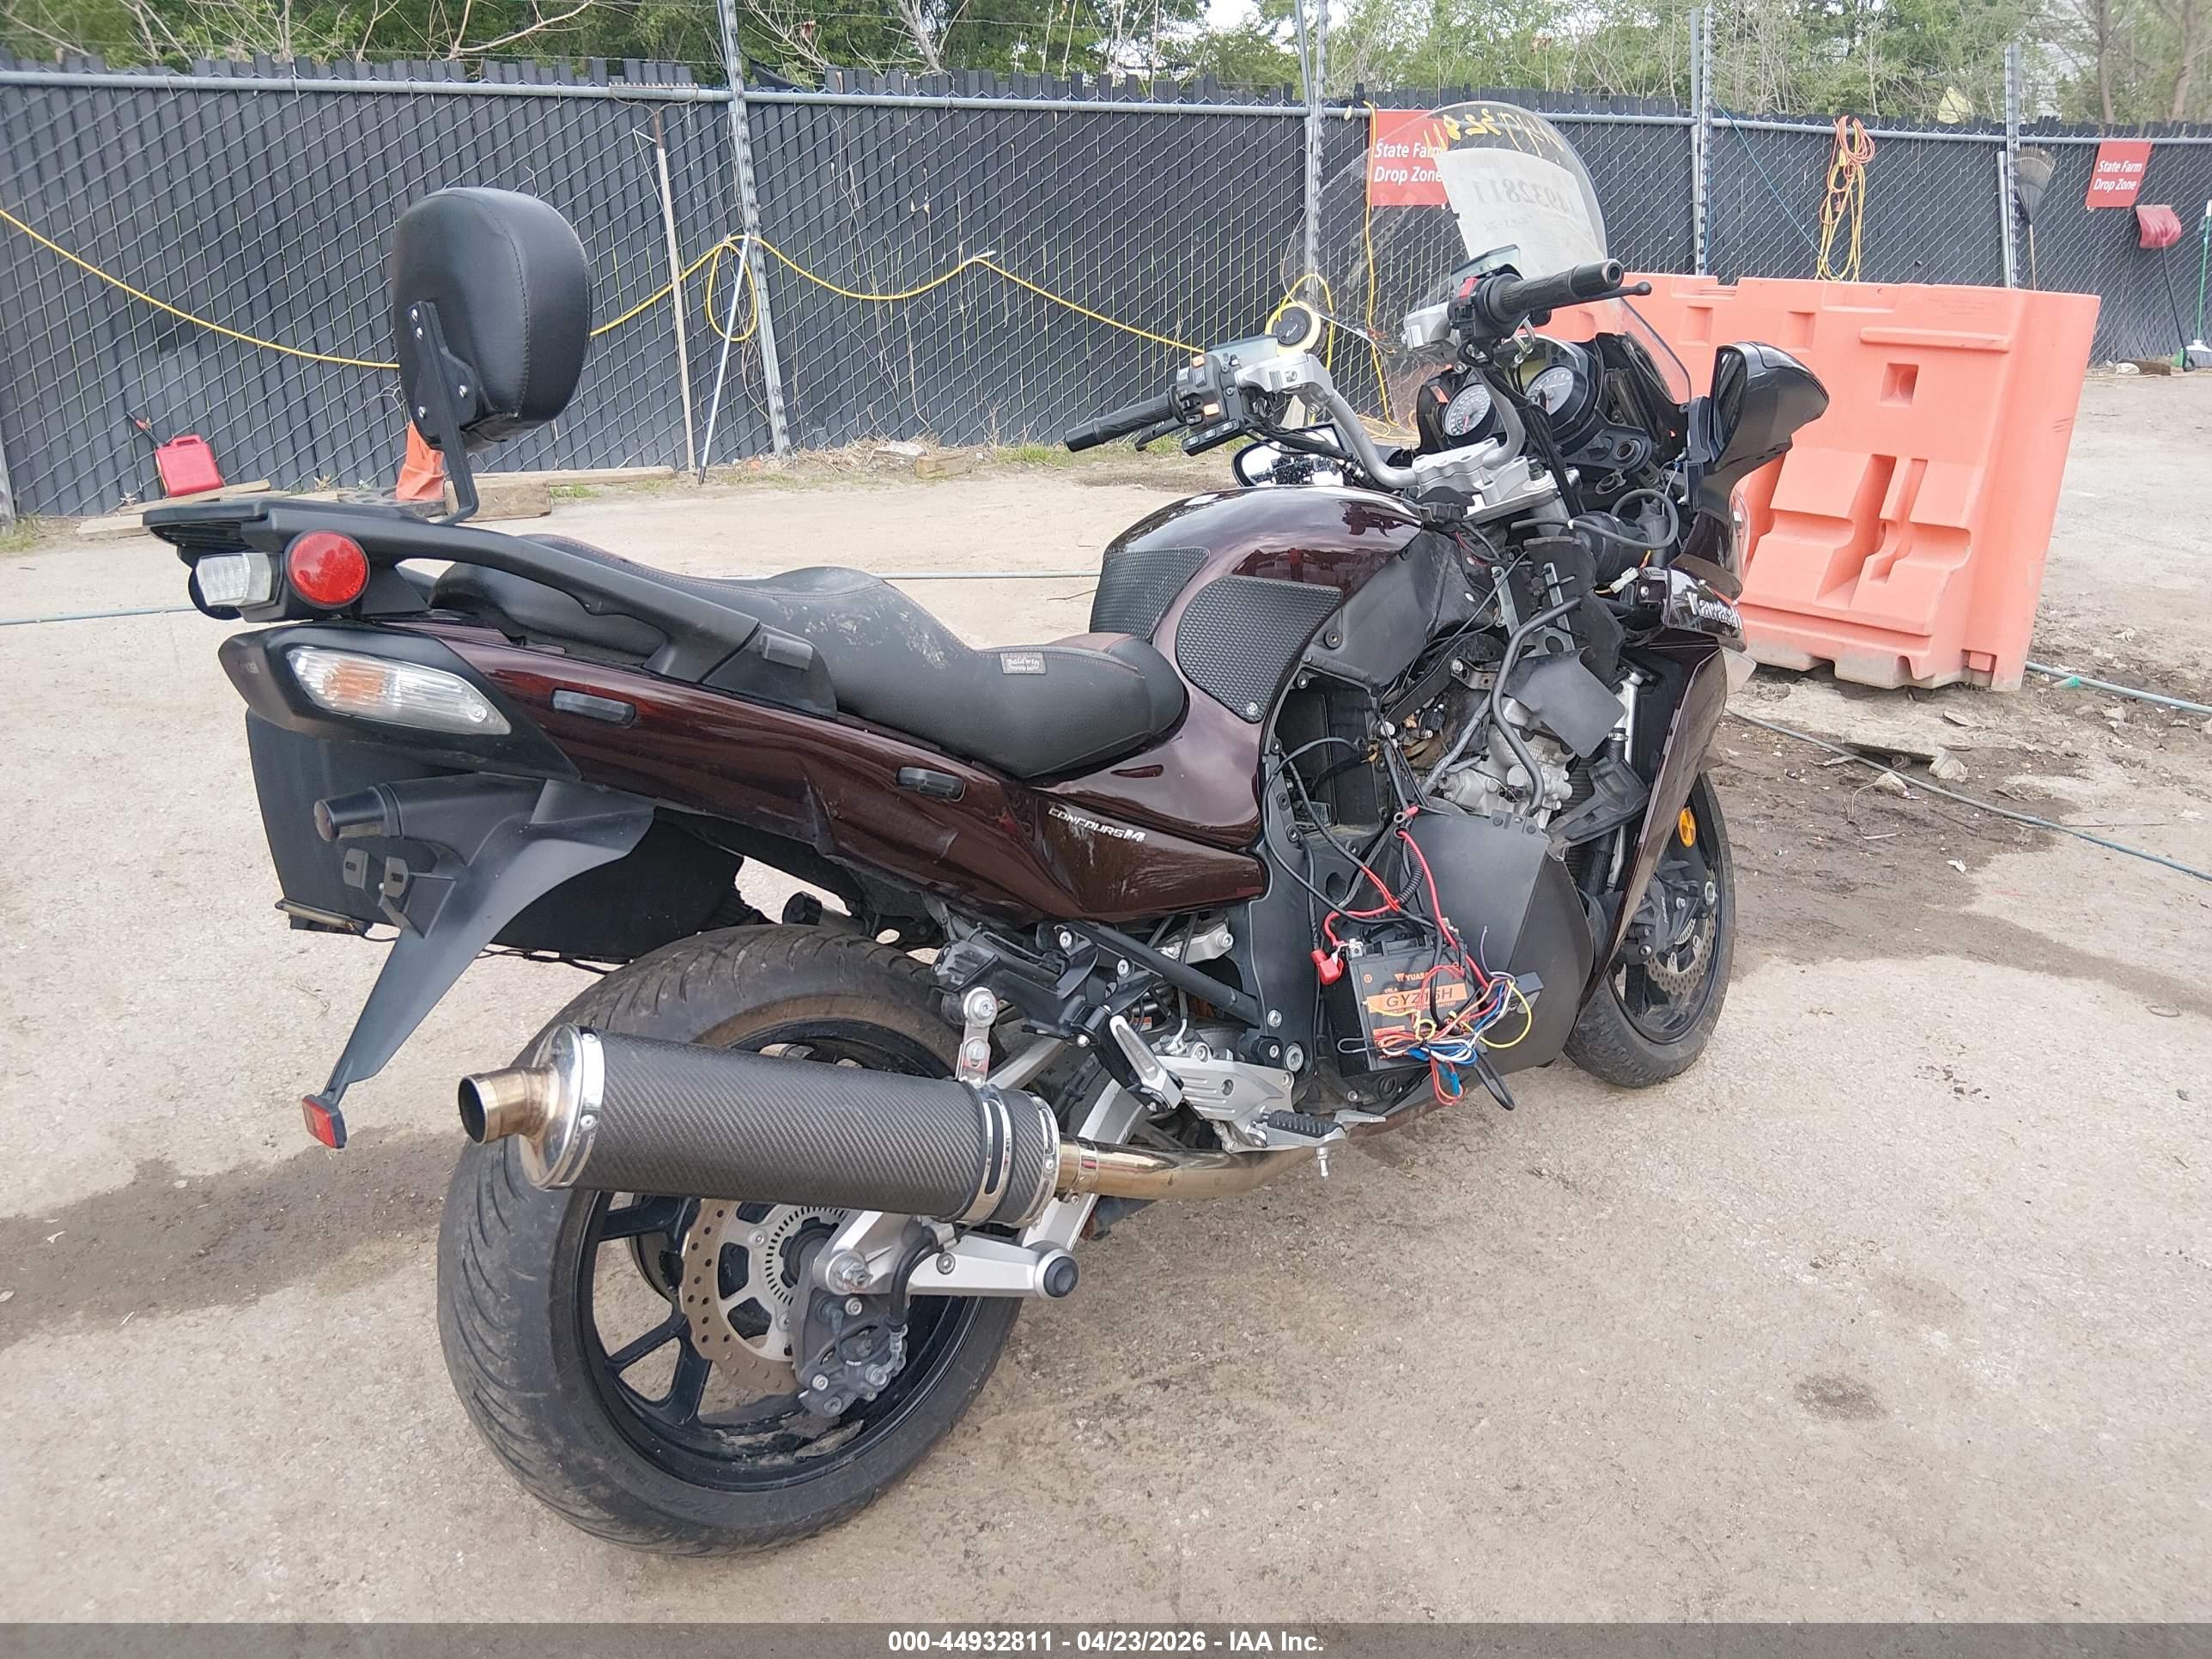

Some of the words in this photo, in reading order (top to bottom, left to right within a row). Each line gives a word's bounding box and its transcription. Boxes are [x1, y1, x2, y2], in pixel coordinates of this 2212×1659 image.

[1374, 142, 1410, 159] State
[2098, 161, 2121, 173] State
[2121, 161, 2142, 173] Farm
[1373, 166, 1408, 186] Drop
[1411, 166, 1443, 183] Zone
[2094, 179, 2115, 192] Drop
[2115, 179, 2136, 190] Zone
